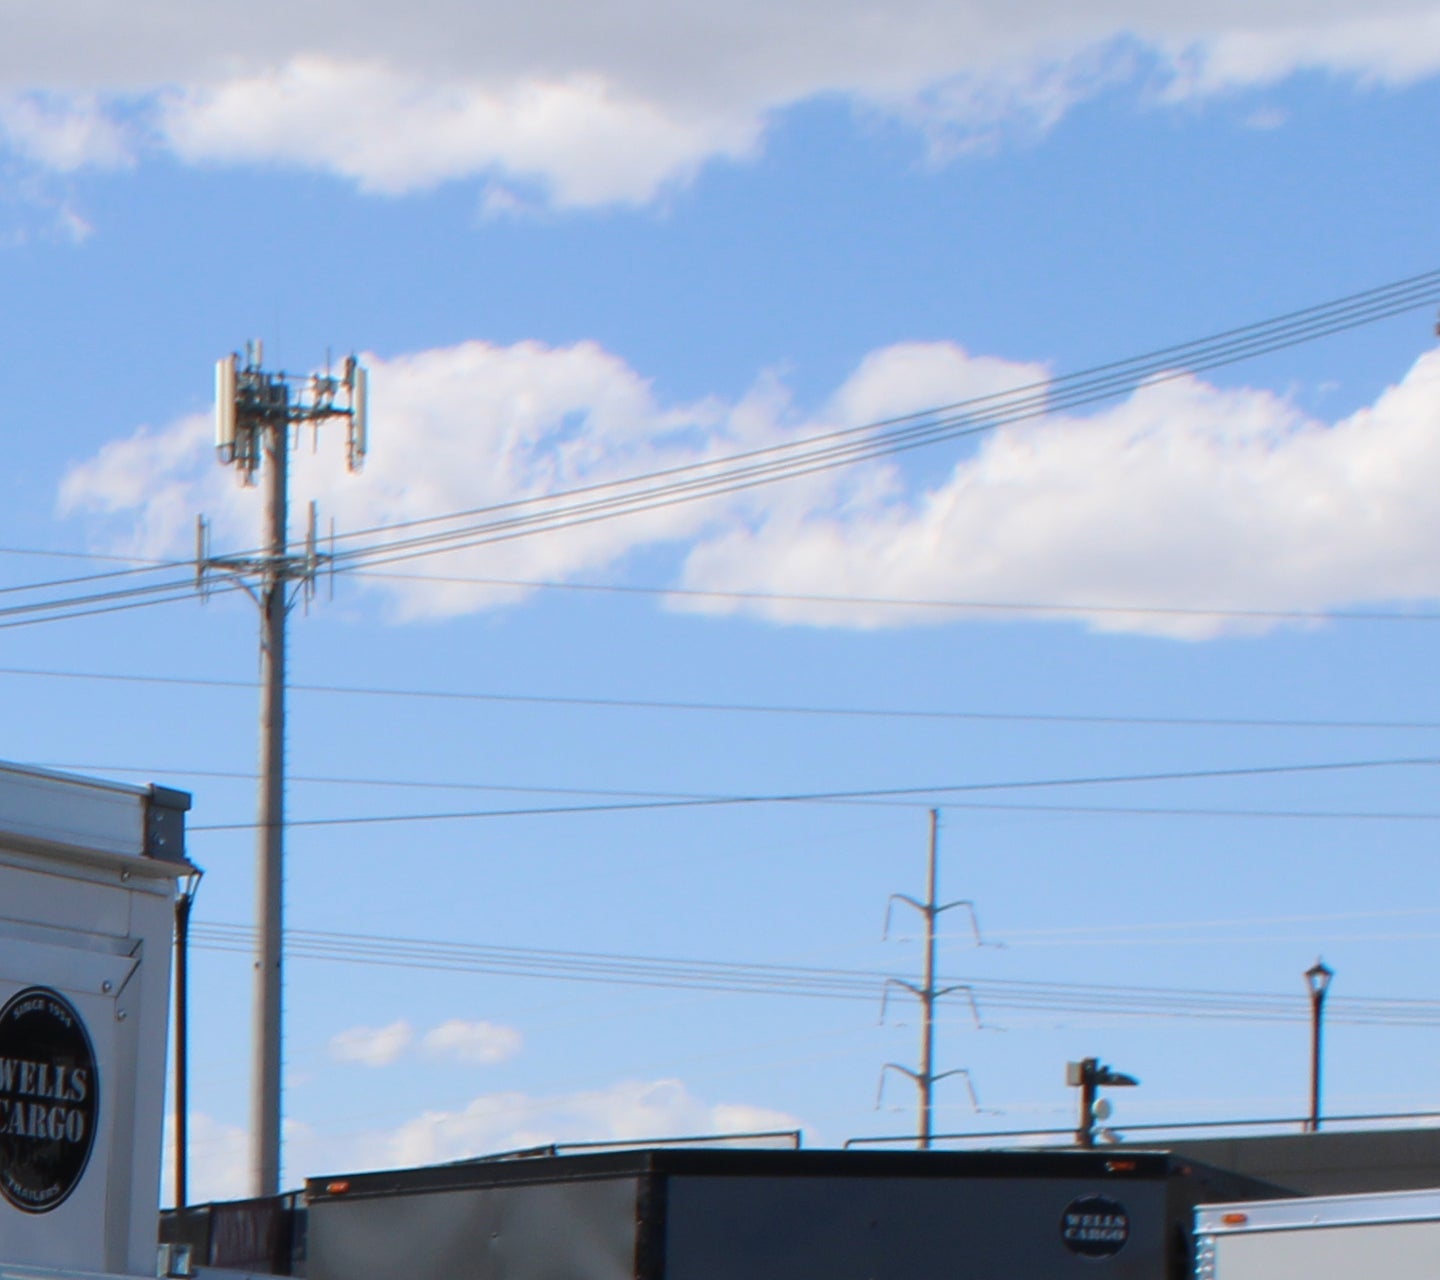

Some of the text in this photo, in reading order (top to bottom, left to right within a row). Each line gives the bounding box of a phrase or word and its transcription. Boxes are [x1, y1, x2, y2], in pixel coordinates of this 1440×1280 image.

[5, 1176, 61, 1202] TRAILERS
[1065, 1213, 1127, 1227] WELLS
[1063, 1227, 1125, 1241] CARGO
